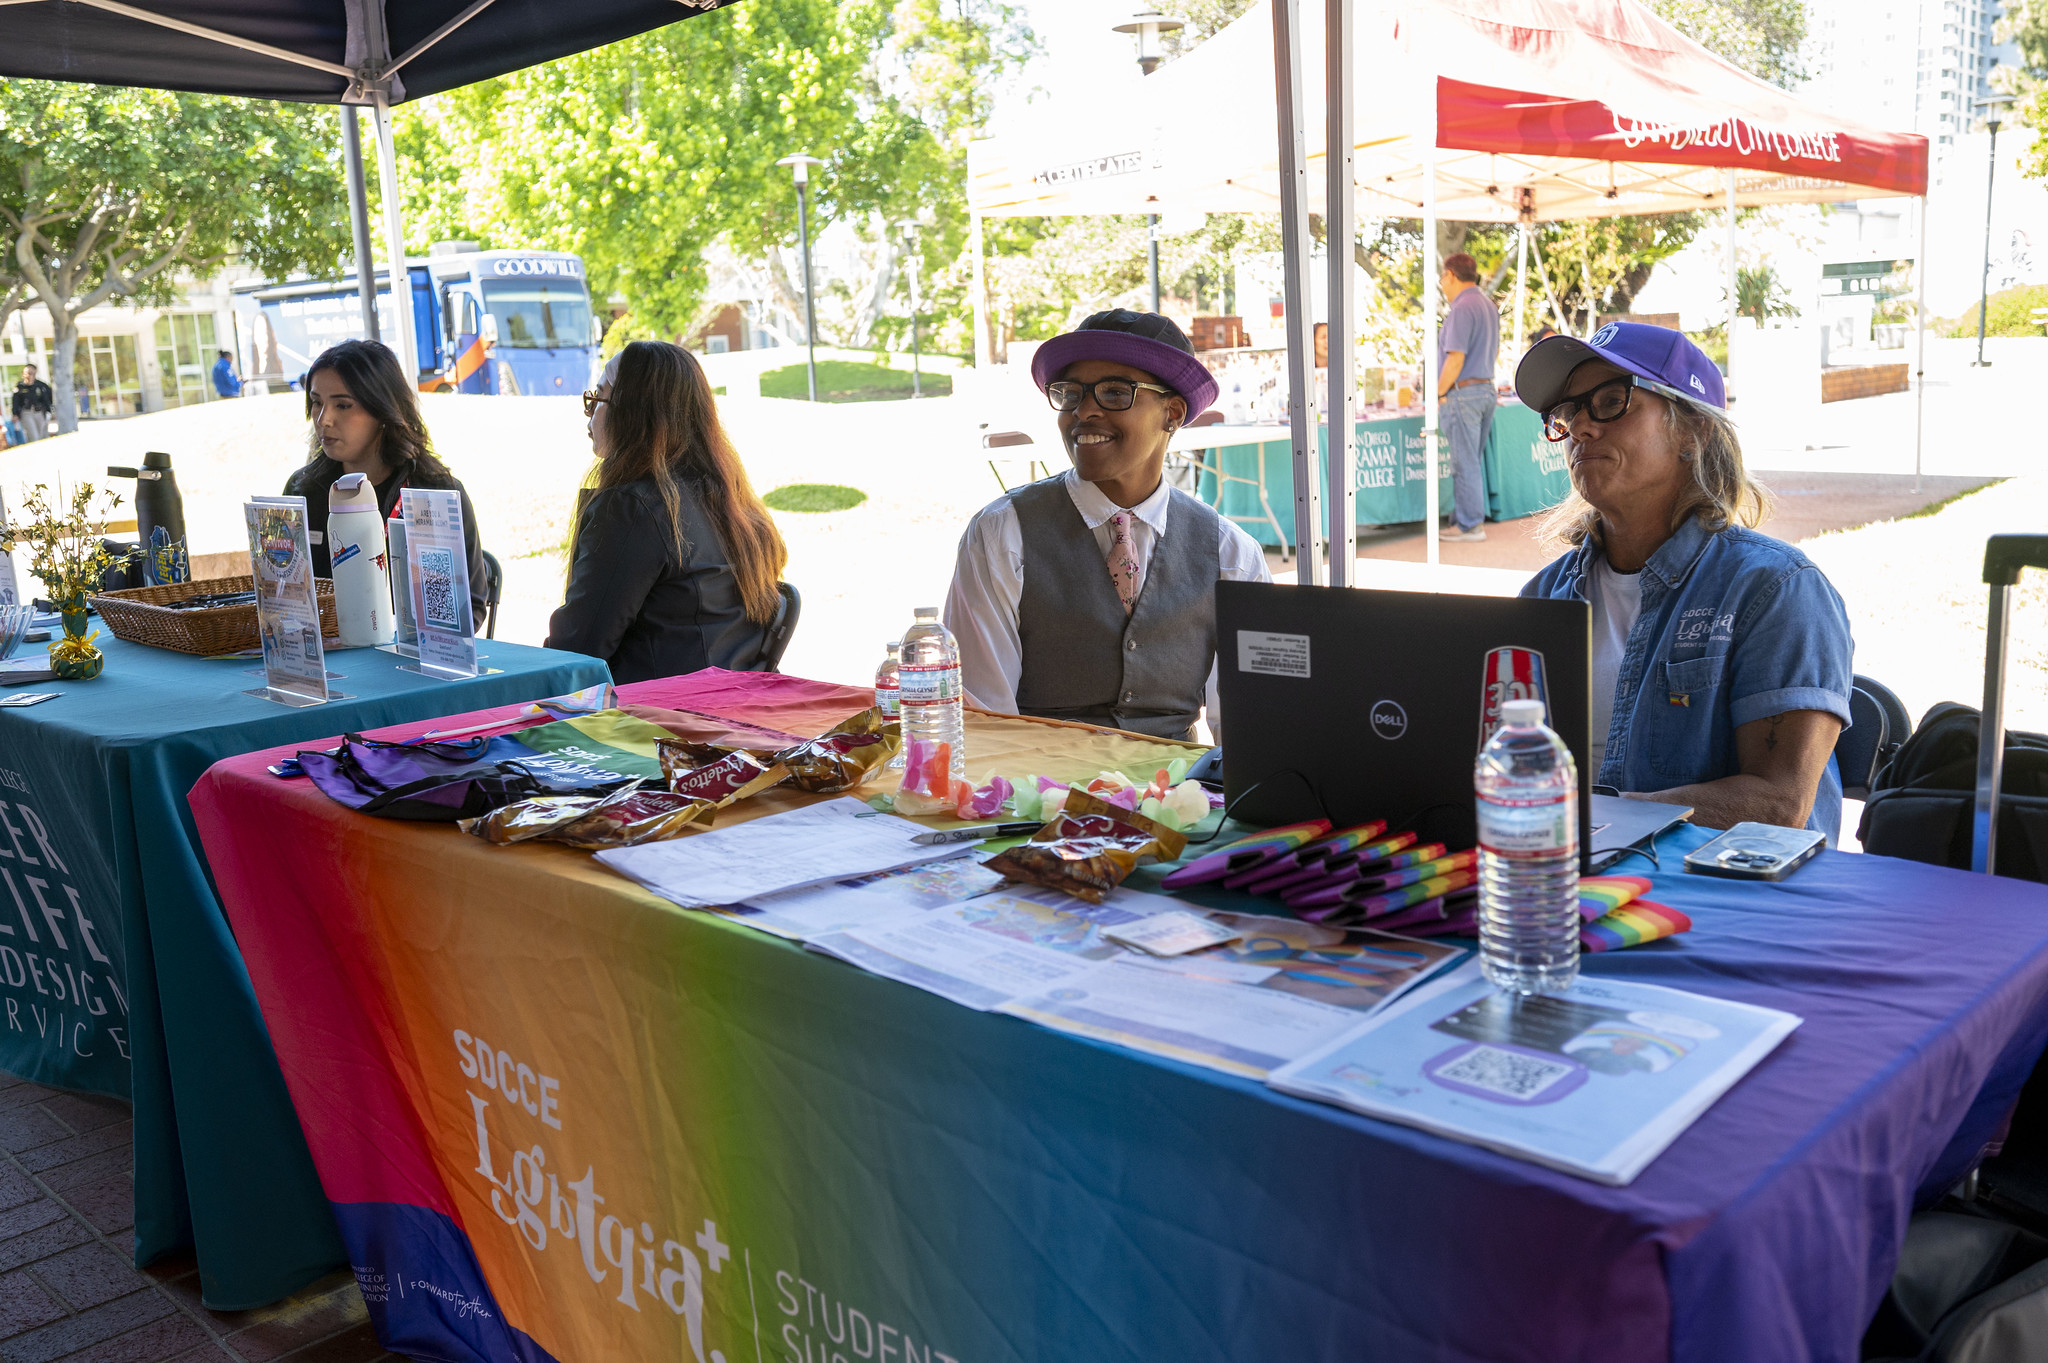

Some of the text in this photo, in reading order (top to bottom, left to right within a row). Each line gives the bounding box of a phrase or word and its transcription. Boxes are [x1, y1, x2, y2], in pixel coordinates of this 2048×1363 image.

[1050, 151, 1141, 185] CERTIFICATES
[493, 258, 580, 277] GOODWILL
[1355, 445, 1397, 467] RAMAR
[1681, 607, 1716, 618] SDCCE
[1375, 713, 1404, 726] DELL
[453, 1028, 561, 1131] SDCCE
[354, 1273, 384, 1283] LLEGE OF
[359, 1282, 391, 1292] TINUING
[776, 1270, 959, 1363] STUDEN
